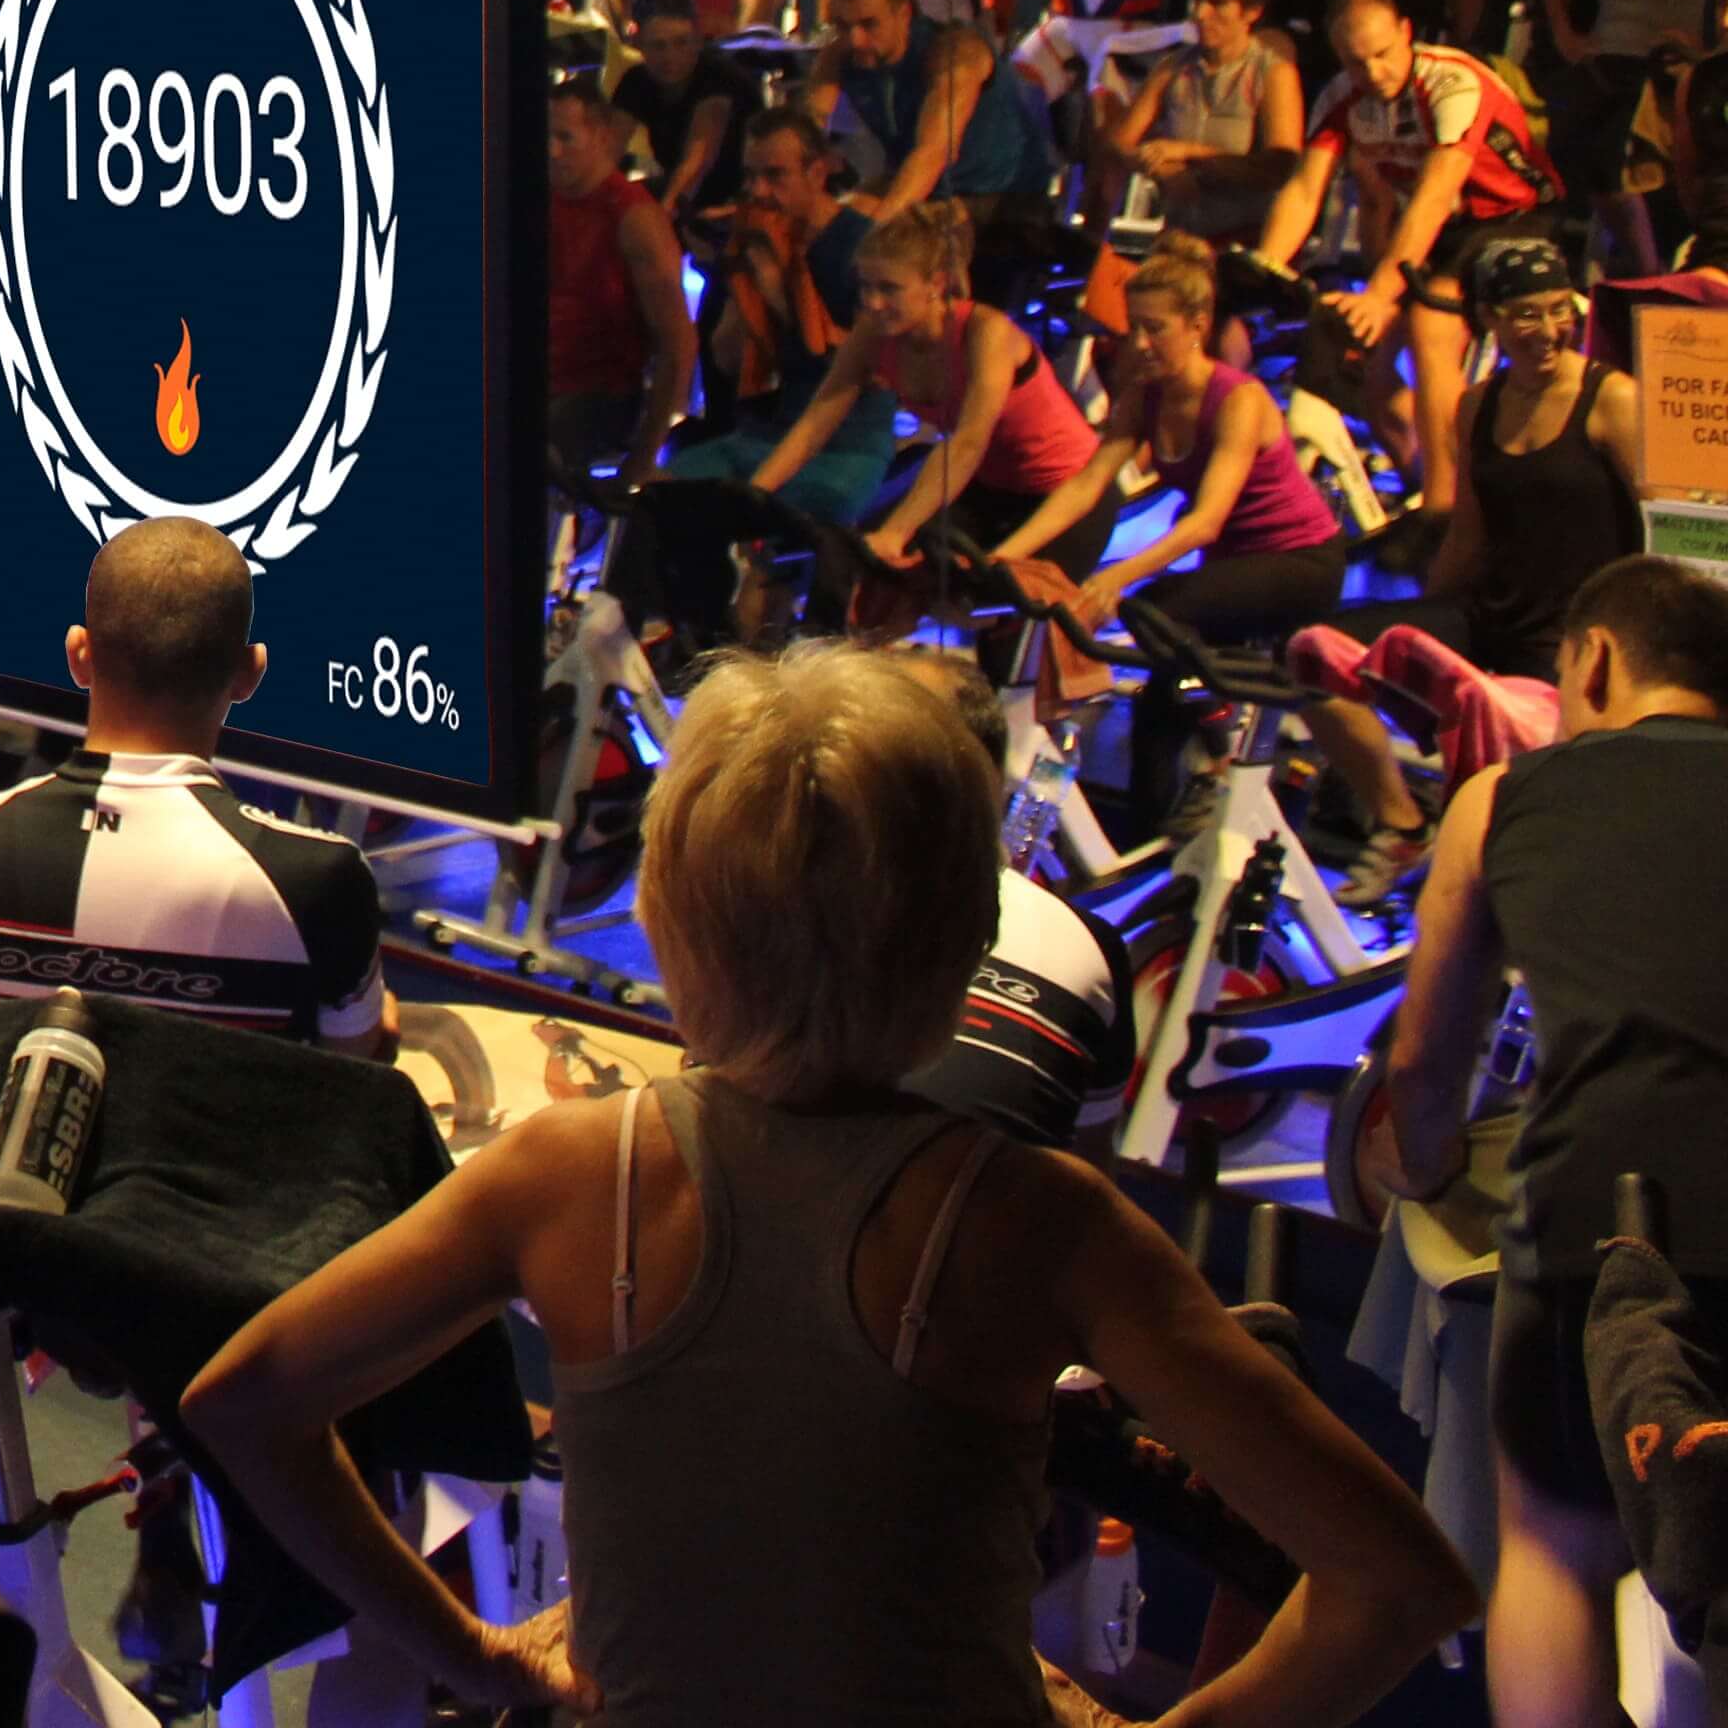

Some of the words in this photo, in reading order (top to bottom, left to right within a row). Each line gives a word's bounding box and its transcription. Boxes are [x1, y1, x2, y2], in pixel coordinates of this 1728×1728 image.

[48, 66, 308, 220] 18903
[1662, 376, 1703, 395] POR
[1659, 400, 1684, 419] TU
[328, 661, 364, 710] FC
